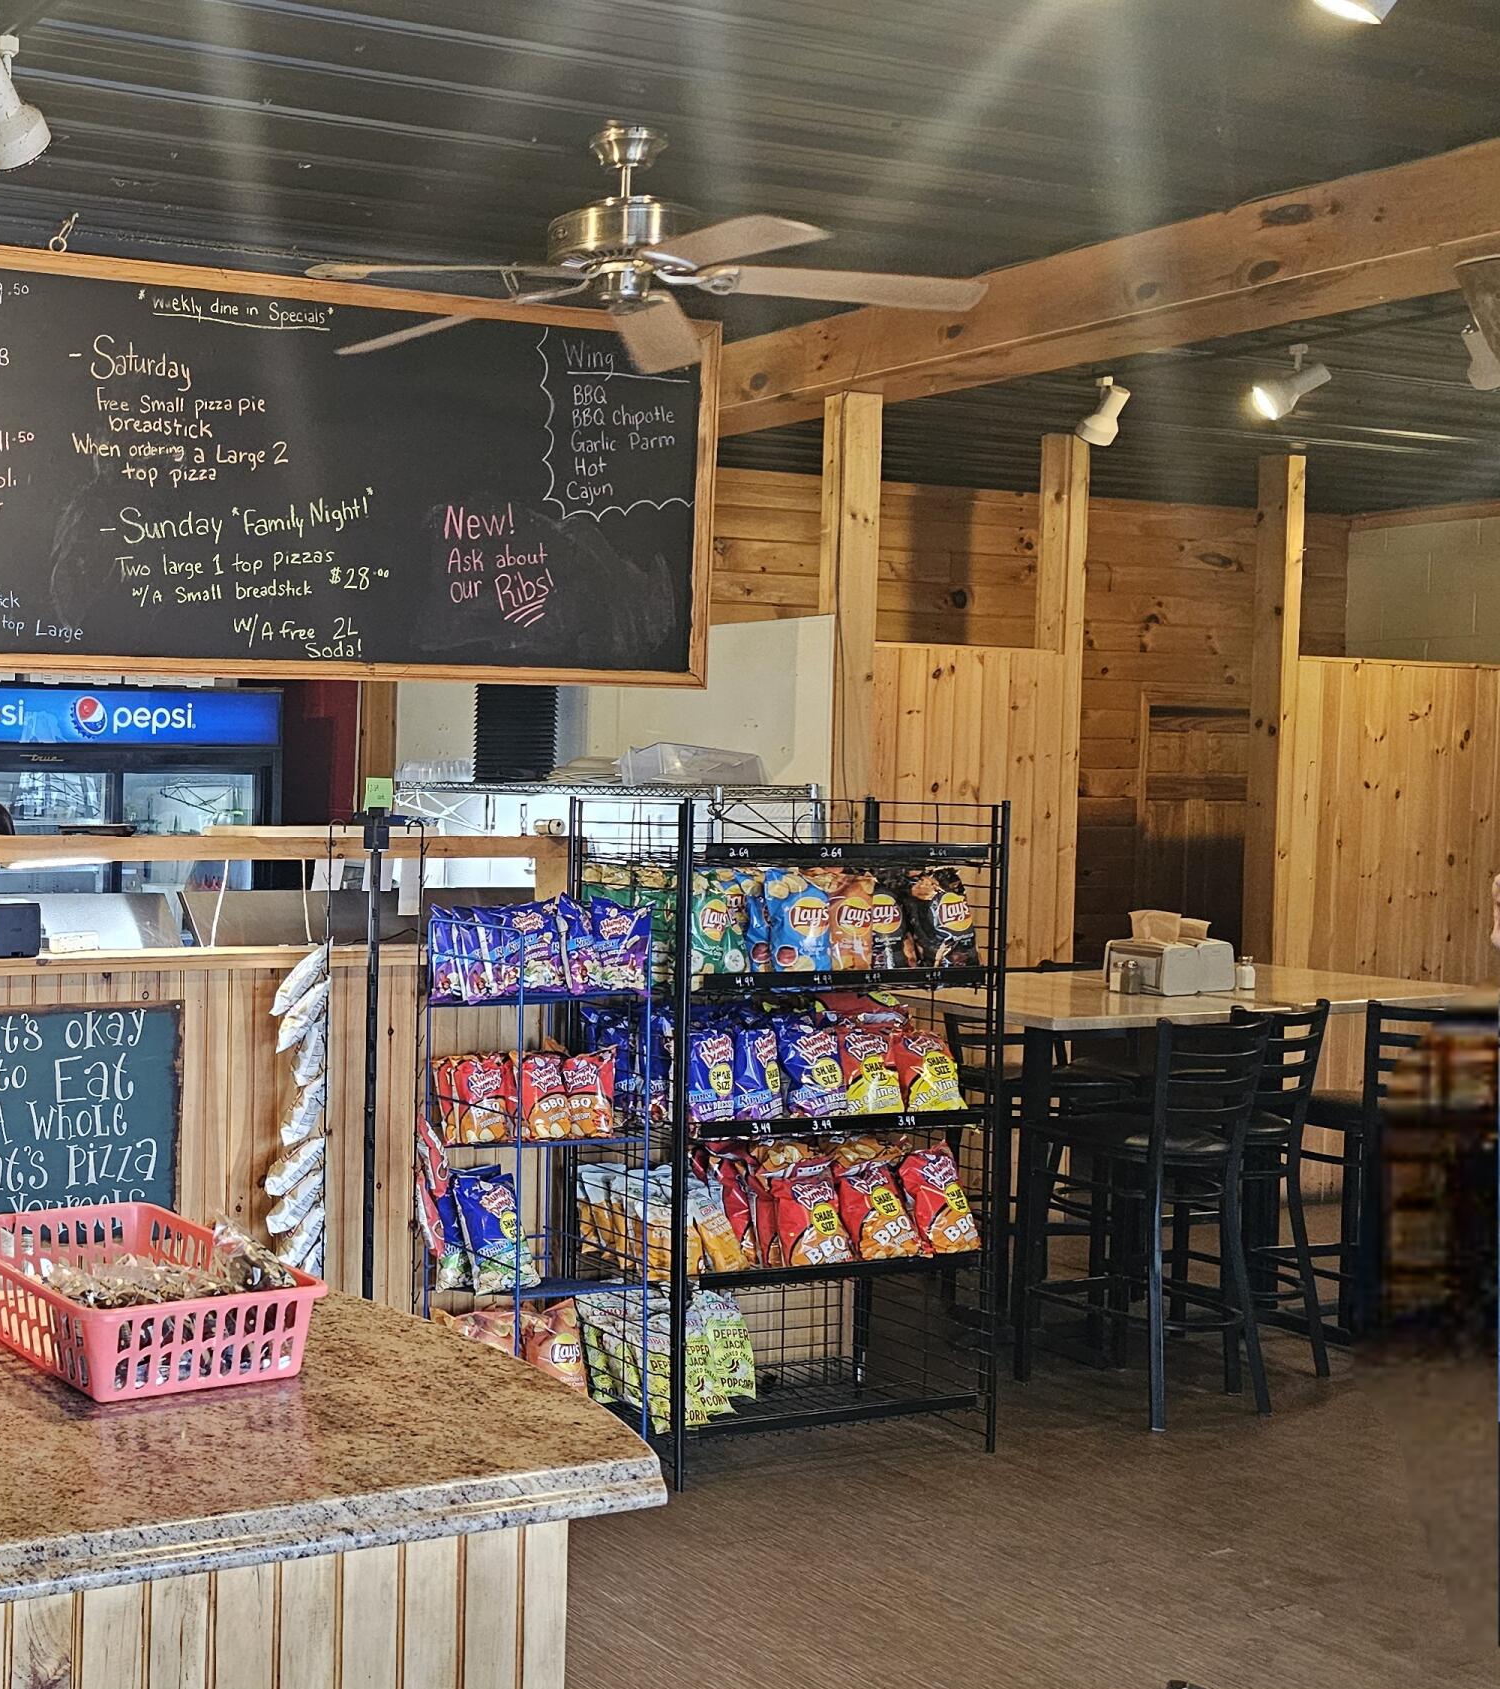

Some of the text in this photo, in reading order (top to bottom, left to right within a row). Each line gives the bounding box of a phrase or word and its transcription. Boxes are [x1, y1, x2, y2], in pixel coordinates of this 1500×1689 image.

[210, 298, 239, 316] dine
[246, 305, 259, 316] in
[269, 301, 325, 329] Specials
[91, 335, 192, 391] Saturday
[562, 340, 615, 381] Wing
[96, 387, 266, 420] Free Small pizza pie
[573, 384, 608, 406] BBQ
[109, 417, 213, 440] breadstick
[572, 407, 605, 429] BBQ
[71, 433, 289, 471] When ordering a Large 2
[571, 431, 675, 453] Garlic Parm
[122, 462, 217, 487] top pizza
[575, 457, 607, 476] Hot
[566, 479, 613, 506] Cajun
[119, 506, 223, 544] Sunday
[444, 502, 515, 540] New!
[114, 556, 151, 583] Two
[163, 553, 204, 580] large
[213, 553, 224, 575] 1
[232, 557, 263, 578] top
[448, 542, 548, 574] Ask about
[329, 566, 389, 592] $28.00
[450, 569, 554, 611] our Ribs!
[175, 583, 222, 603] Small
[236, 578, 313, 601] breadstick
[2, 617, 25, 637] top
[35, 619, 83, 643] Large
[332, 616, 359, 639] 2L
[305, 638, 362, 658] Soda!
[113, 703, 193, 735] pepsi
[729, 848, 749, 858] 2.69
[821, 847, 842, 857] 2.69
[736, 976, 755, 987] 4.99
[816, 1064, 838, 1077] SHARE
[927, 1056, 947, 1067] SHARE
[935, 1065, 951, 1075] SIZE
[54, 1052, 134, 1102] Eat
[716, 1080, 731, 1091] SIZE
[822, 1075, 838, 1086] SIZE
[541, 1098, 564, 1113] BBQ
[569, 1097, 591, 1108] BQ
[848, 1099, 863, 1114] alt
[752, 1122, 771, 1134] 3.49
[898, 1115, 915, 1126] 3.49
[873, 1193, 893, 1205] SHARE
[882, 1203, 897, 1216] SIZE
[814, 1211, 834, 1223] SHARE
[821, 1221, 835, 1232] SIZE
[873, 1216, 911, 1247] BBQ
[805, 1235, 846, 1265] BBQ
[713, 1328, 749, 1341] PEPPER
[724, 1340, 745, 1349] JACK
[686, 1345, 710, 1357] EPPER
[690, 1356, 707, 1367] JACK
[701, 1395, 728, 1407] PCORN
[685, 1410, 707, 1421] CORN
